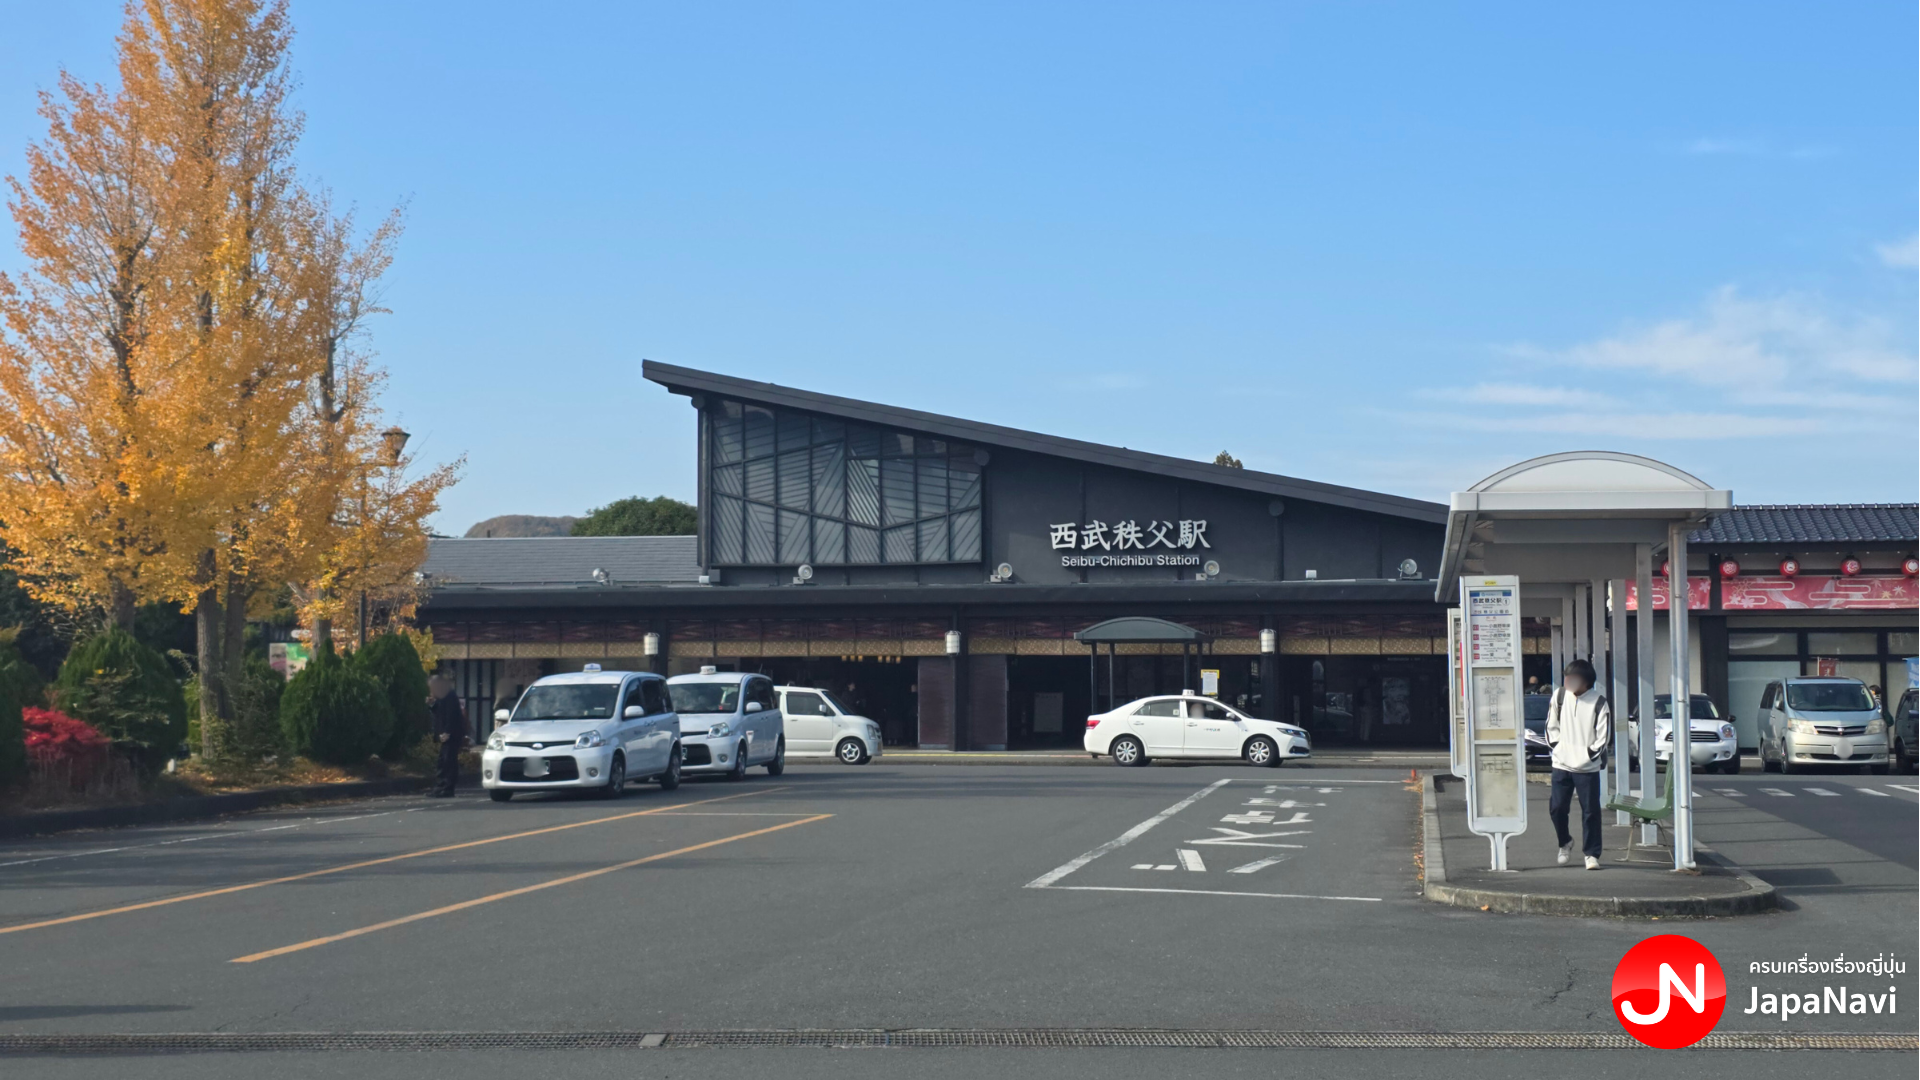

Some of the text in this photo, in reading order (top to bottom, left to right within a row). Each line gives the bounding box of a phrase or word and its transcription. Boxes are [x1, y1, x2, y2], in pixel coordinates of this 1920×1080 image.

[1050, 520, 1211, 551] 西武秩父駅
[1061, 554, 1200, 567] Seibu-Chichibu Station
